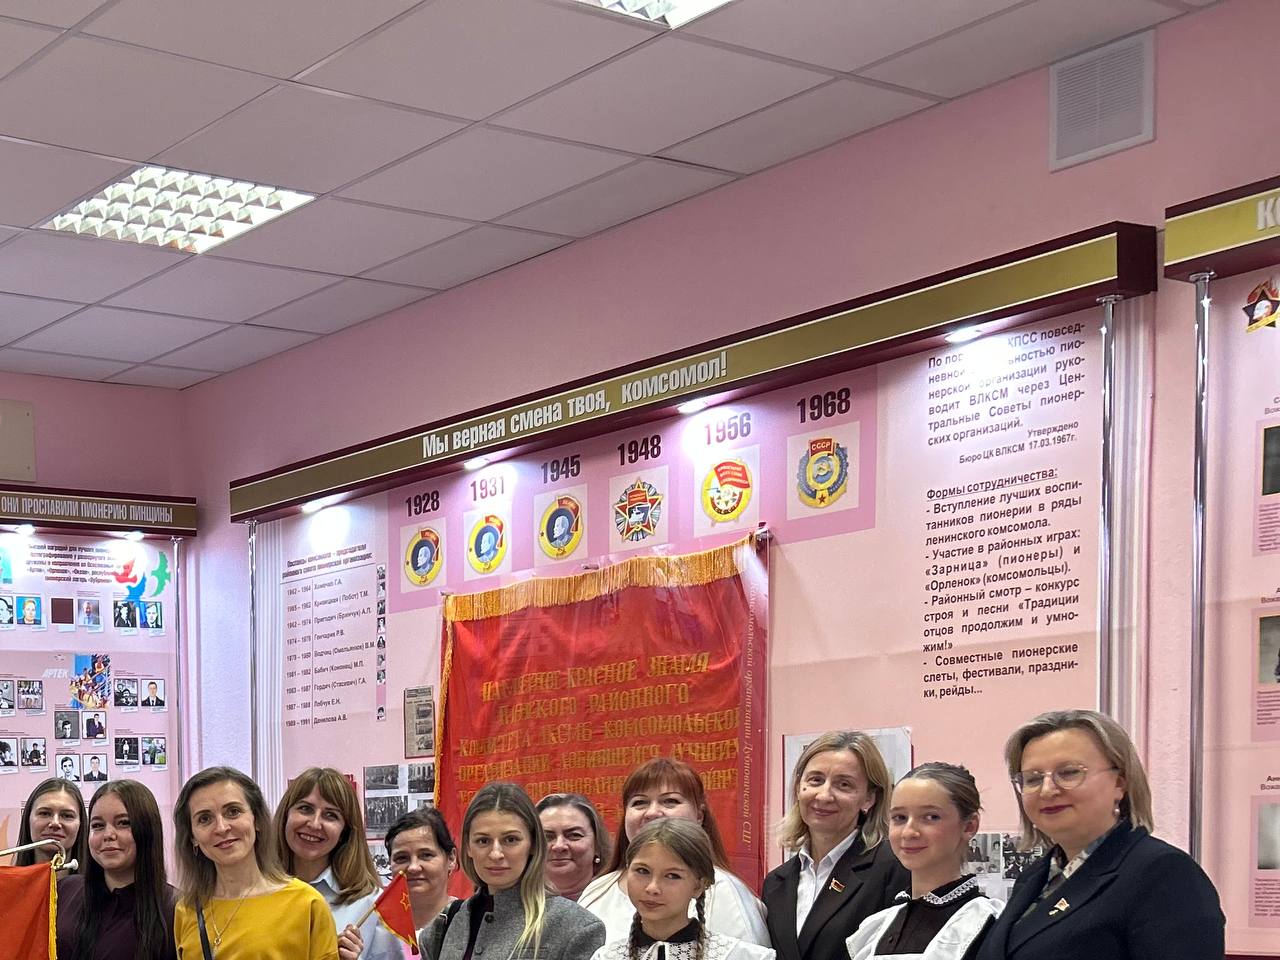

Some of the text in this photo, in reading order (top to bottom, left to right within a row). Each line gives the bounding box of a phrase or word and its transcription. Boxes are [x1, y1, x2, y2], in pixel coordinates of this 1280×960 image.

[1040, 323, 1085, 341] повсед-
[1055, 357, 1085, 372] руко-
[797, 388, 850, 423] 1968
[929, 374, 1085, 416] водит ВЛКСМ через Цен-
[423, 433, 449, 458] Мы
[453, 423, 506, 450] верная
[510, 407, 562, 434] смена
[567, 390, 610, 418] твоя,
[928, 390, 1085, 431] тральные Советы пионер-
[705, 412, 751, 445] 1956
[928, 418, 1023, 446] ских организаций.
[1027, 421, 1079, 438] Утверждено
[617, 434, 661, 465] 1948
[811, 440, 831, 450] СССР
[959, 433, 1077, 464] Бюро ВЛКСМ 17.03.1967г.
[541, 455, 581, 483] 1945
[470, 476, 505, 501] 1931
[927, 468, 1058, 499] Формы сотрудничества:
[933, 481, 1082, 514] Вступление лучших воспи-
[1, 496, 173, 523] ОНИ ПРОСЛАВИЛИ ПИОНЕРИЮ ПИНЩИНЫ
[405, 490, 440, 517] 1928
[926, 496, 1082, 531] танников пионерии ряды
[926, 518, 1051, 546] ленинского комсомола.
[932, 529, 1080, 561] Участие районных играх:
[925, 549, 1063, 576] «Зарница» (пионеры)
[925, 577, 981, 593] «Орленок»
[931, 578, 1079, 606] Районный смотр конкурс
[924, 594, 1079, 624] строя песни «Традиции
[924, 611, 1079, 638] отцов продолжим умно-
[923, 641, 953, 653] жим!»
[935, 642, 1078, 667] Совместные пионерские
[923, 658, 1078, 683] слеты, фестивали, праздни-
[940, 684, 982, 698] рейды...
